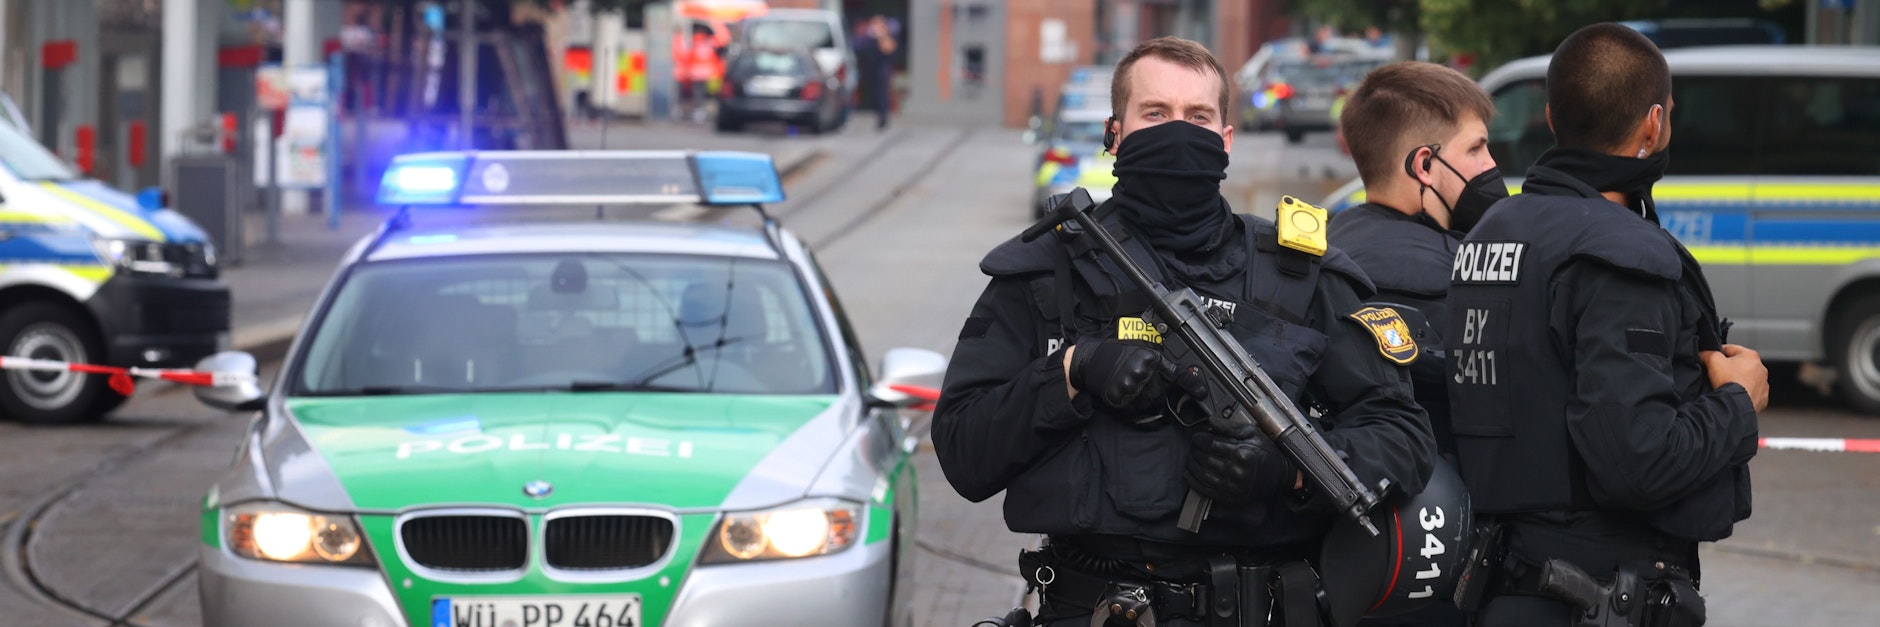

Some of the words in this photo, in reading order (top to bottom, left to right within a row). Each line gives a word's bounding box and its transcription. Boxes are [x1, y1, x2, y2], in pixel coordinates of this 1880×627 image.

[1451, 242, 1524, 282] POLIZEI
[1122, 320, 1154, 332] VIDE
[1463, 308, 1489, 345] BY
[1454, 349, 1497, 385] 3411
[396, 432, 693, 460] POLIZEI
[1407, 505, 1446, 599] 3411
[574, 602, 634, 627] 464
